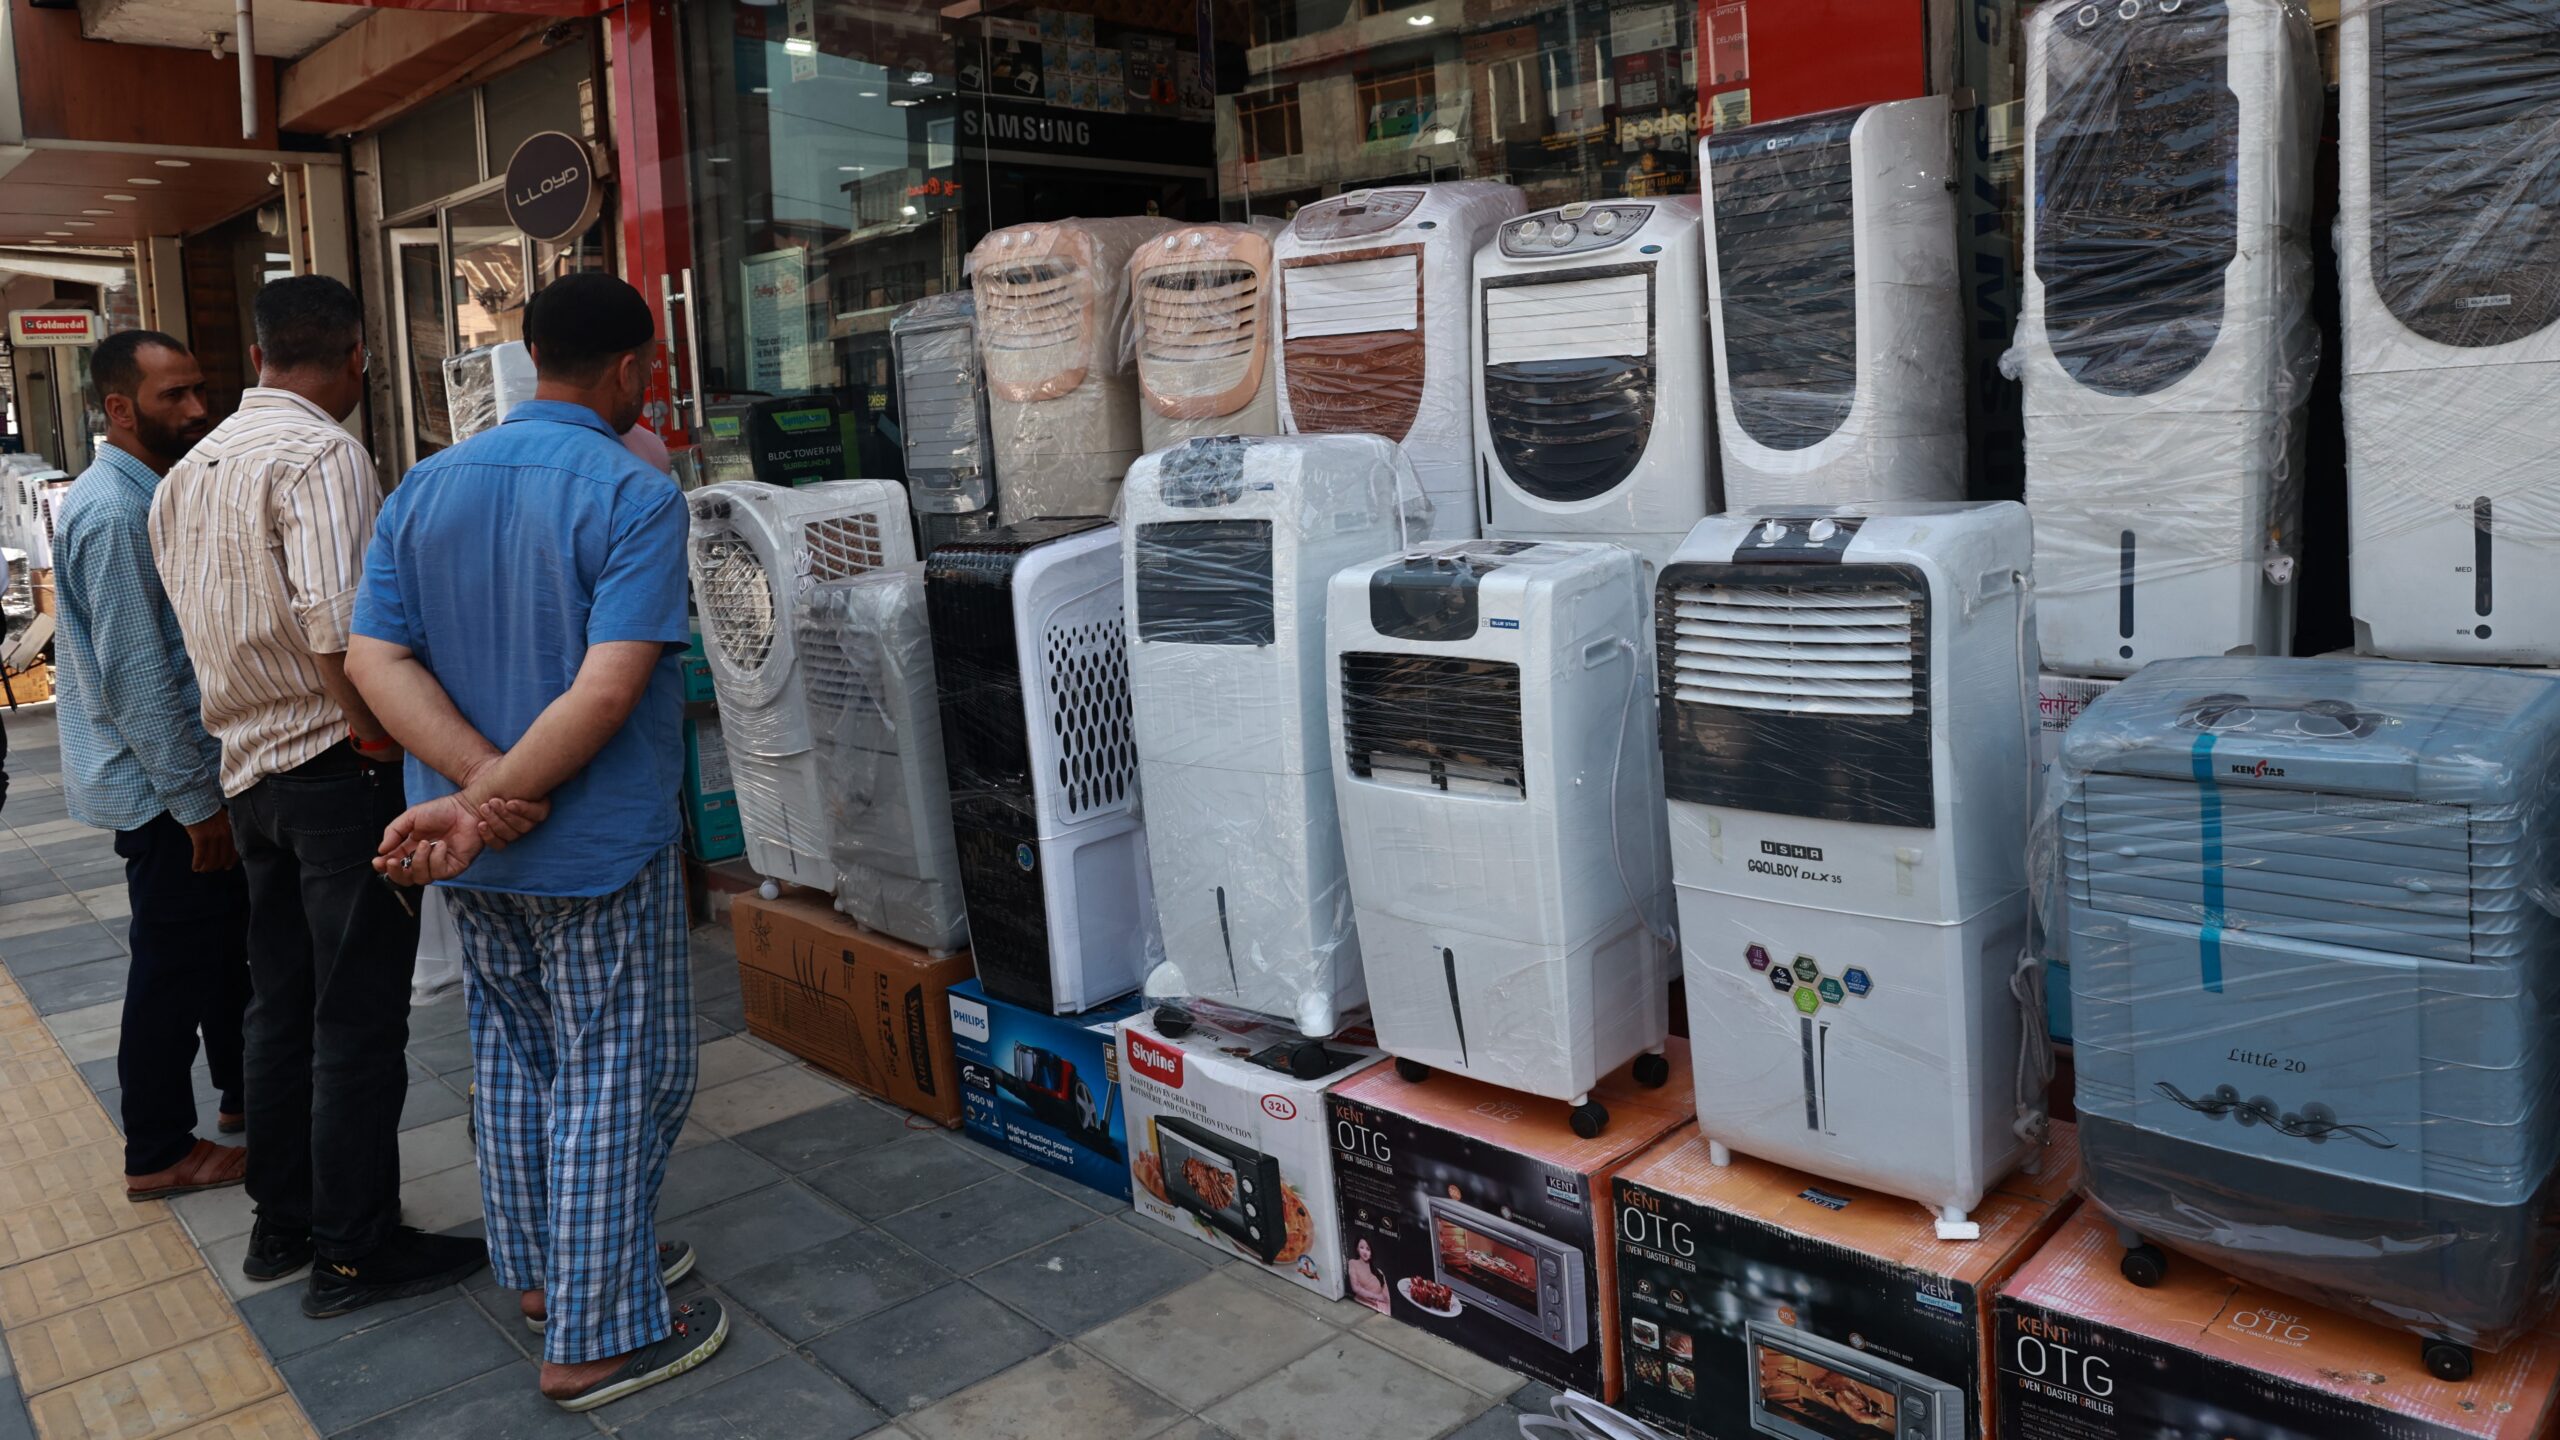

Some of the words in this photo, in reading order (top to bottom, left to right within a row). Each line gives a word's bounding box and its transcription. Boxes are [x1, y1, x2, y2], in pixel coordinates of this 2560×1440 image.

[963, 109, 1090, 146] SAMSUNG
[516, 167, 579, 206] LLOYD
[36, 320, 84, 330] Goldmedal
[768, 451, 791, 461] BLDC
[794, 446, 825, 459] TOWER
[826, 444, 842, 454] FAN
[2455, 503, 2471, 511] MAX
[2231, 760, 2286, 779] KENSTAR
[1762, 842, 1821, 860] USHA
[1801, 871, 1829, 882] DLX
[1831, 874, 1843, 884] 35
[953, 1008, 986, 1030] PHILIPS
[909, 994, 929, 1087] Symphony
[1131, 1041, 1176, 1074] Skyline
[2227, 1048, 2278, 1069] Little
[2283, 1058, 2306, 1074] 20
[966, 1091, 986, 1107] 1900
[987, 1099, 995, 1110] W
[1129, 1074, 1154, 1093] TOASTER
[1154, 1085, 1171, 1098] OVEN
[1171, 1092, 1190, 1108] GRILL
[1190, 1098, 1208, 1114] WITH
[1130, 1084, 1162, 1105] ROTISSERIE
[1162, 1100, 1175, 1111] AND
[1175, 1105, 1217, 1127] CONVECTION
[1217, 1119, 1253, 1140] FUNCTION
[1268, 1100, 1289, 1114] 32L
[1335, 1105, 1364, 1125] KENT
[1006, 1122, 1028, 1137] Higher
[1028, 1131, 1052, 1147] suction
[1052, 1141, 1074, 1155] power
[1007, 1134, 1023, 1146] with
[1023, 1138, 1068, 1161] PowerCyclone
[1068, 1156, 1074, 1165] 5
[1337, 1120, 1391, 1162] OTG
[1354, 1155, 1374, 1169] TOASTER
[1374, 1161, 1394, 1176] GRILLER
[1549, 1177, 1575, 1193] KENT
[1623, 1189, 1660, 1214] KENT
[1624, 1206, 1694, 1257] OTG
[1625, 1244, 1642, 1256] OVEN
[1643, 1247, 1670, 1265] TOASTER
[1670, 1257, 1696, 1273] GRILLER
[1920, 1294, 1941, 1308] Smart
[1941, 1299, 1958, 1311] Chef
[1921, 1281, 1955, 1302] KENT
[1779, 1309, 1795, 1323] 30L
[1913, 1306, 1935, 1321] HOUSE
[2257, 1307, 2301, 1324] KENT
[2017, 1314, 2069, 1344] KENT
[2227, 1324, 2245, 1334] OVEN
[2233, 1311, 2311, 1341] OTG
[667, 1331, 722, 1377] crocs
[2017, 1336, 2113, 1397] OTG
[2019, 1377, 2041, 1393] OVEN
[2042, 1384, 2078, 1405] TOASTER
[2080, 1397, 2114, 1416] GRILLER
